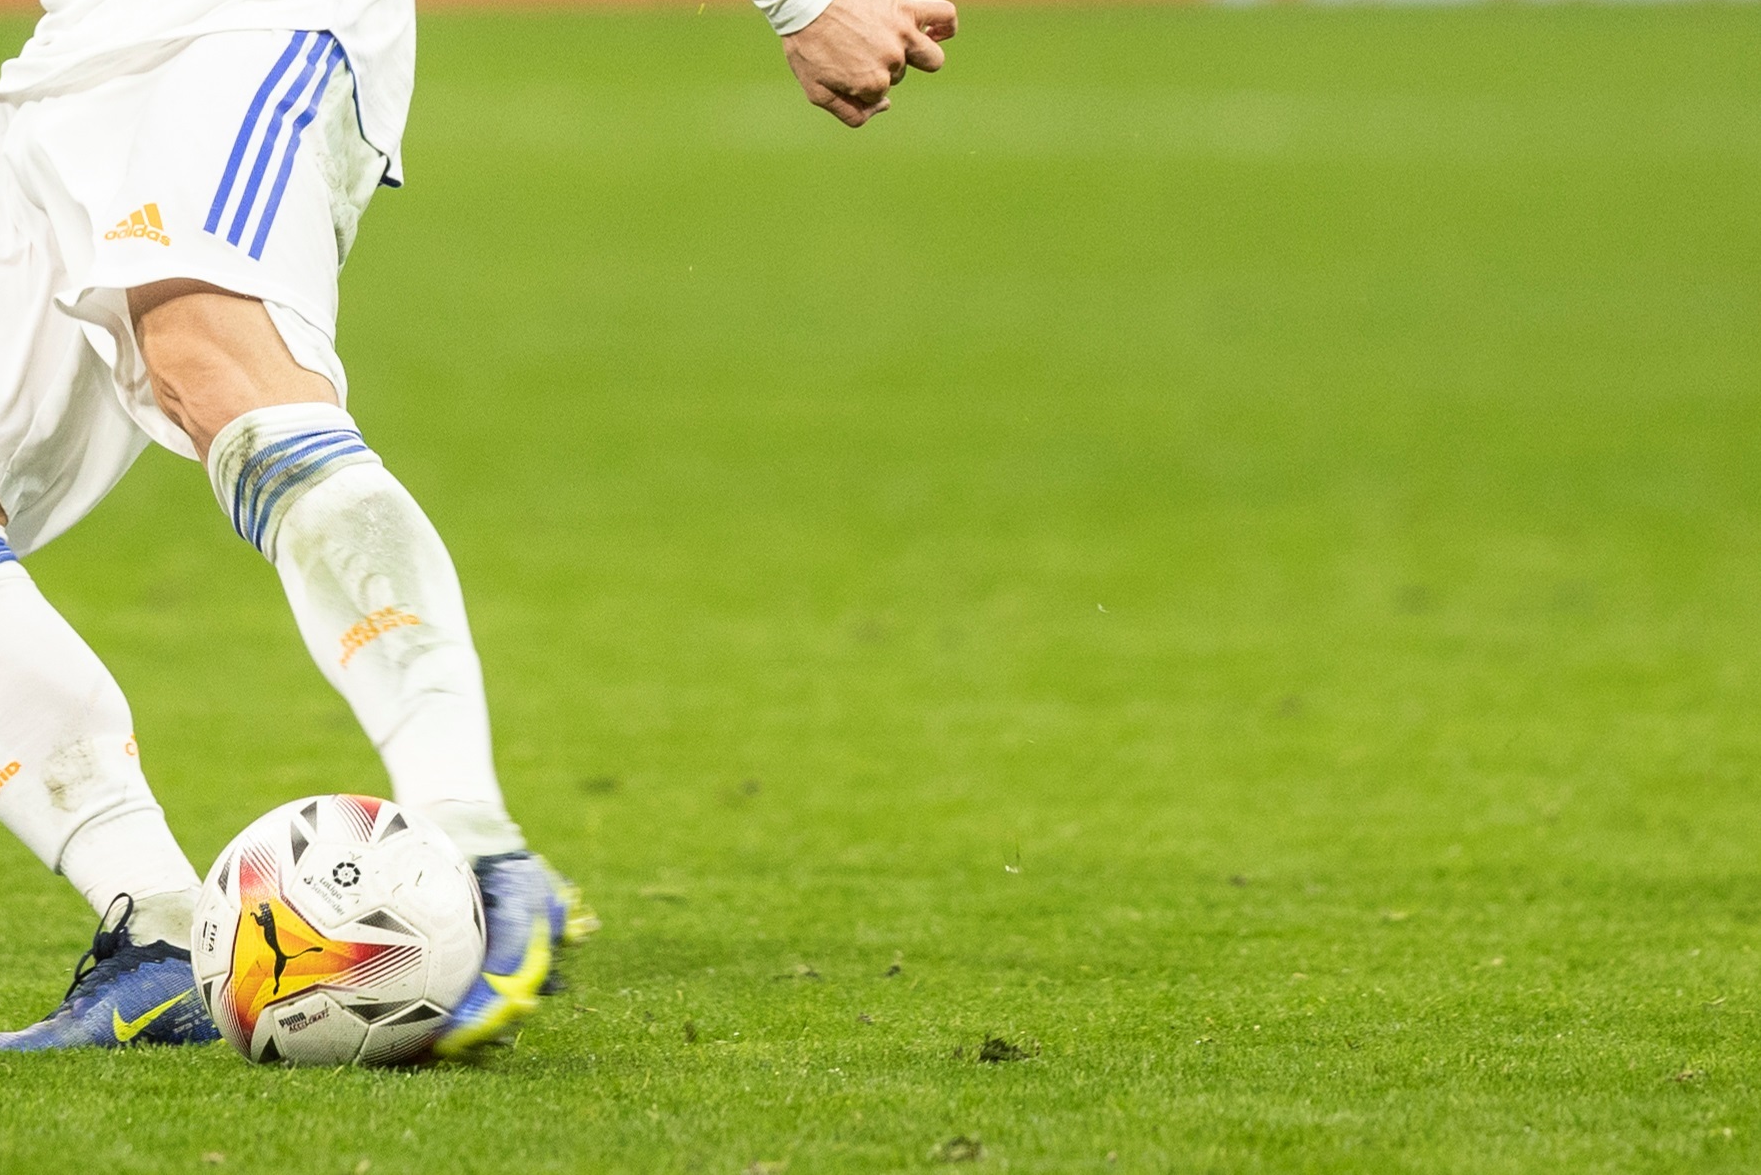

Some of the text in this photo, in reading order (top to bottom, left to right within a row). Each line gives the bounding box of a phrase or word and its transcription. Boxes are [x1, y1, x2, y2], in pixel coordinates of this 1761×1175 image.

[104, 224, 171, 247] adidas
[208, 924, 217, 952] FIFA
[278, 1011, 307, 1028] PUMA
